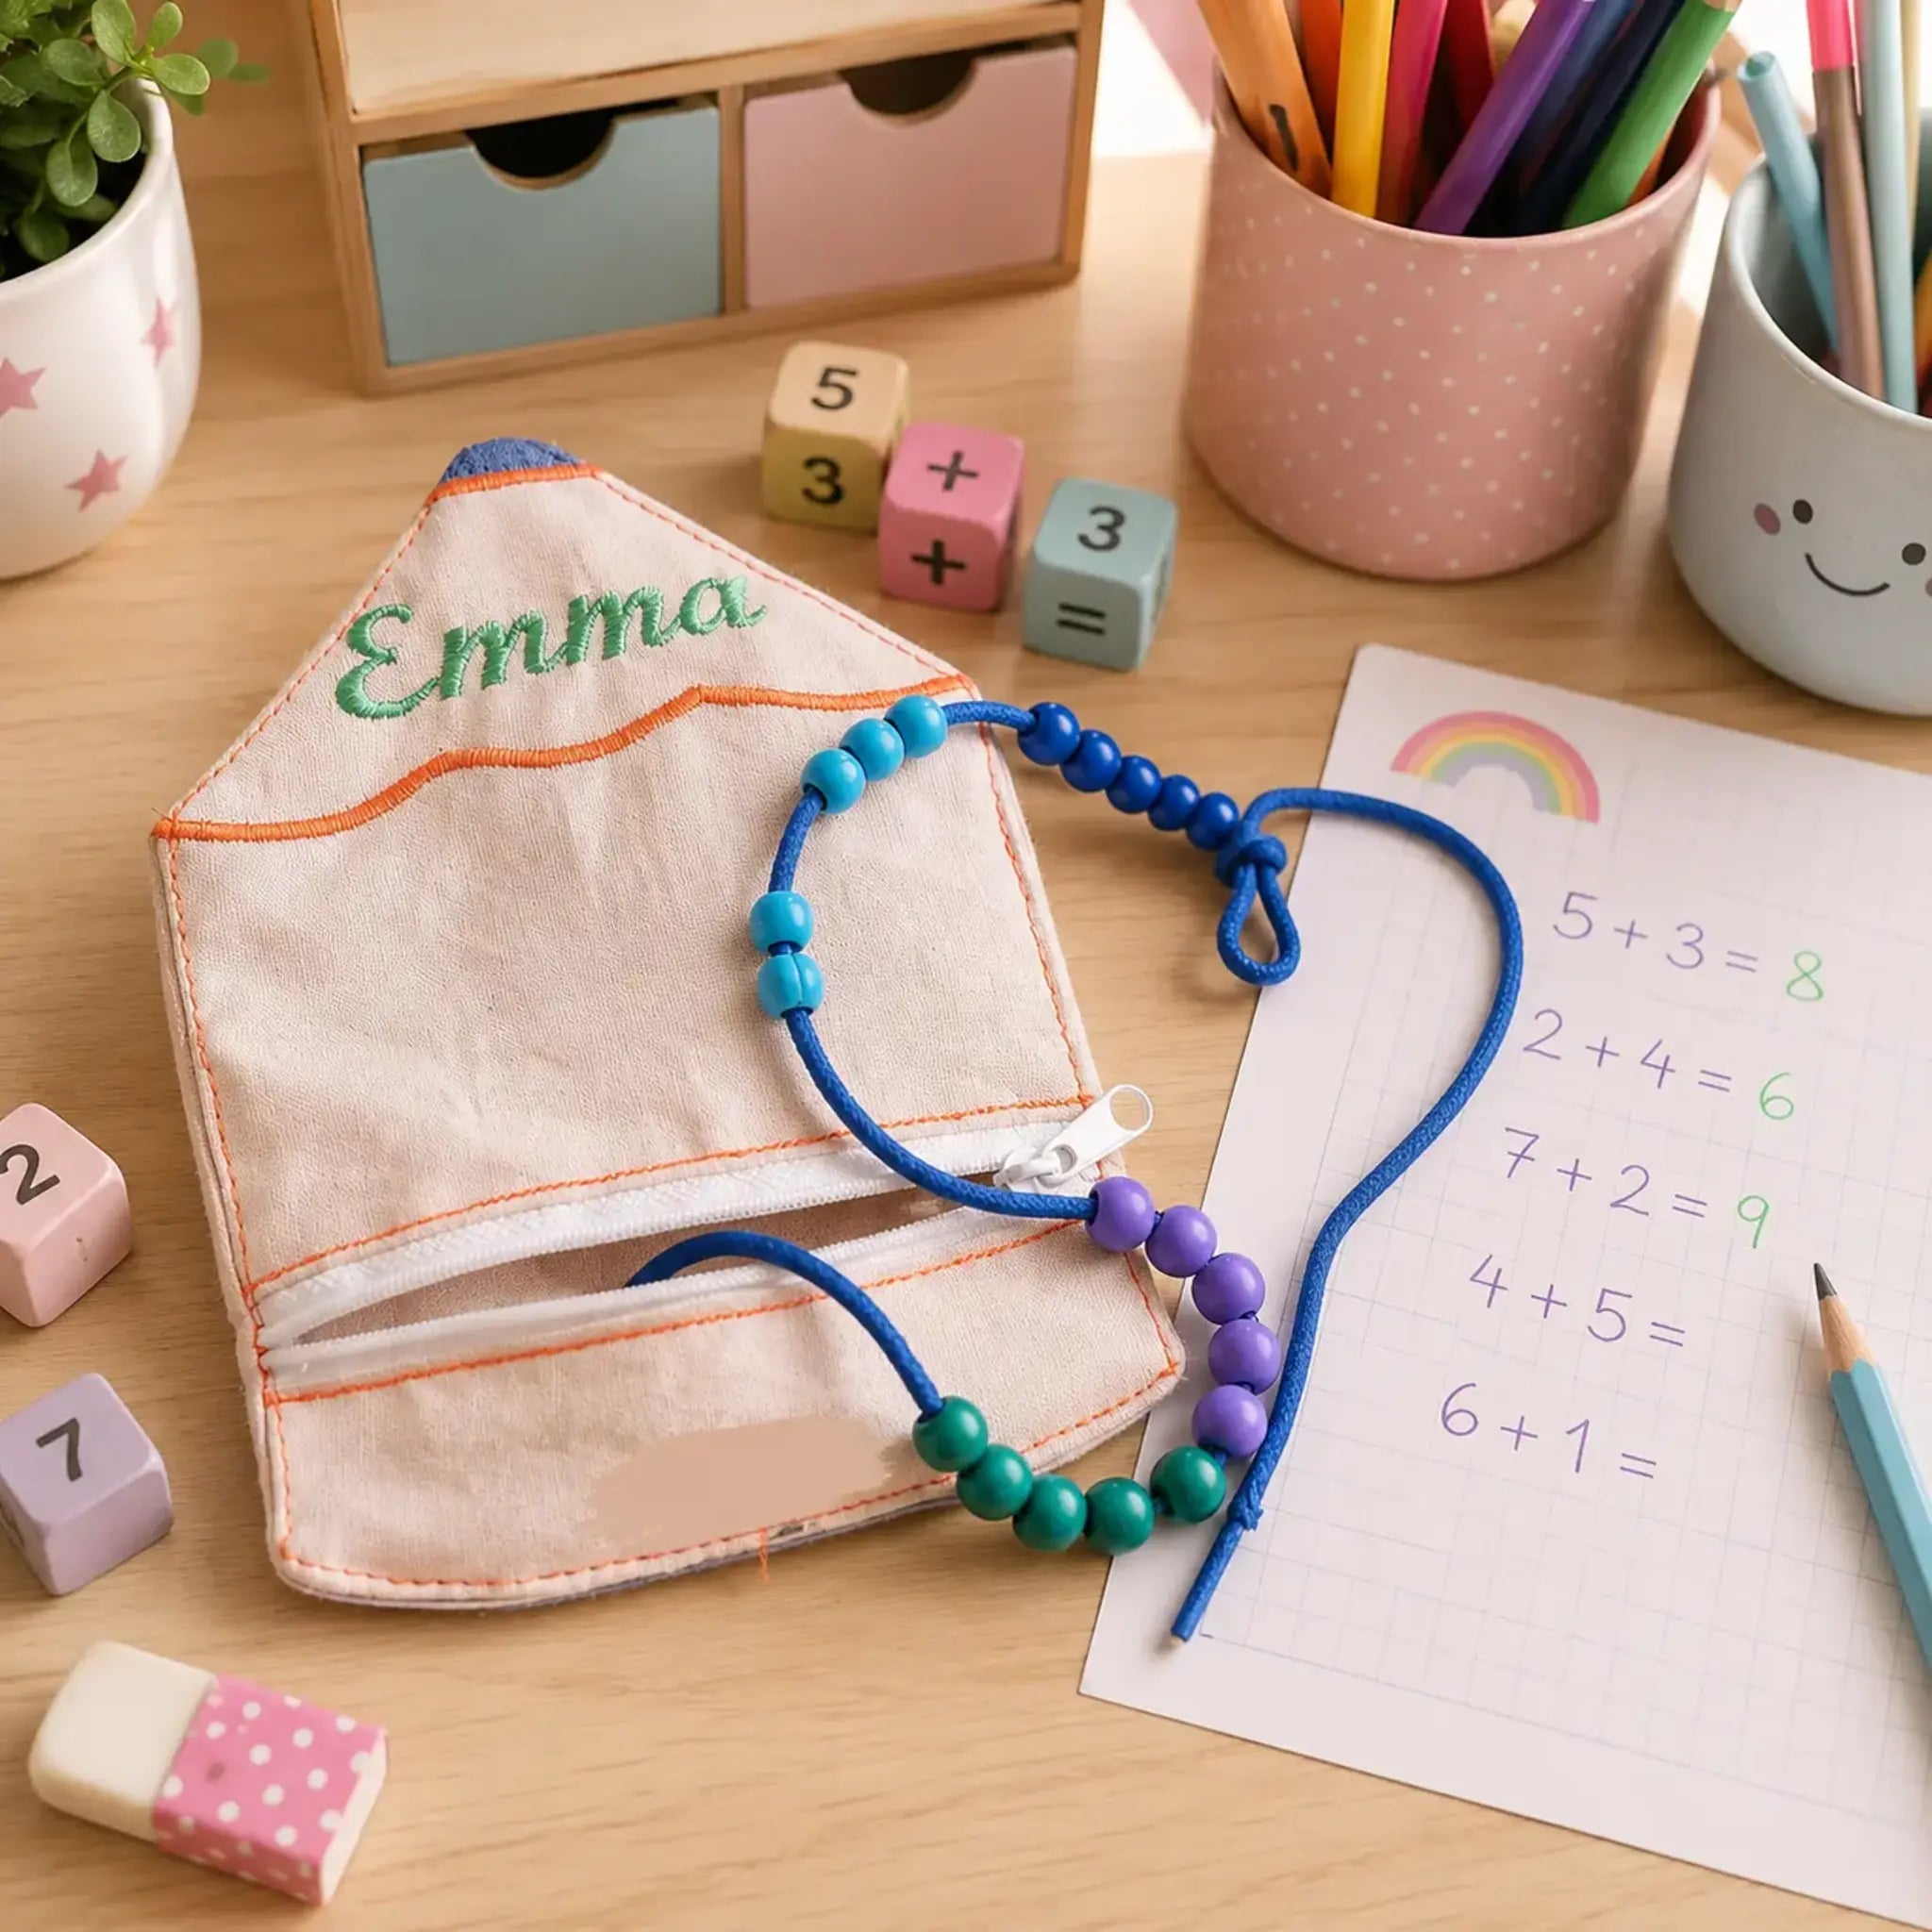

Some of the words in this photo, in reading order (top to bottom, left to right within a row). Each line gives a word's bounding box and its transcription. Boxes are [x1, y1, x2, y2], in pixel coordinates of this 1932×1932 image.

[811, 367, 858, 410] 5
[802, 457, 844, 506] 3
[927, 451, 979, 491] +
[1077, 506, 1125, 552] 3
[911, 540, 967, 586] +
[335, 576, 767, 720] Emma
[1057, 602, 1107, 637] =
[1552, 891, 1599, 941] 5
[1612, 919, 1649, 950] +
[1665, 922, 1706, 970] 3
[1724, 950, 1759, 974] =
[1786, 951, 1824, 1002] 8
[1522, 1008, 1563, 1061] 2
[1584, 1035, 1621, 1069] +
[1639, 1038, 1677, 1090] 4
[1697, 1069, 1733, 1093] =
[1758, 1072, 1795, 1121] 6
[0, 1144, 61, 1206] 2
[1504, 1125, 1541, 1179] 7
[1556, 1158, 1593, 1192] +
[1608, 1164, 1651, 1218] 2
[1672, 1191, 1708, 1219] =
[1737, 1194, 1771, 1250] 9
[1468, 1253, 1509, 1309] 4
[1530, 1283, 1569, 1320] +
[1587, 1287, 1634, 1343] 5
[1648, 1321, 1687, 1348] =
[36, 1417, 83, 1482] 7
[1439, 1382, 1480, 1438] 6
[1499, 1414, 1540, 1452] +
[1564, 1418, 1591, 1474] 1
[1619, 1452, 1657, 1480] =
